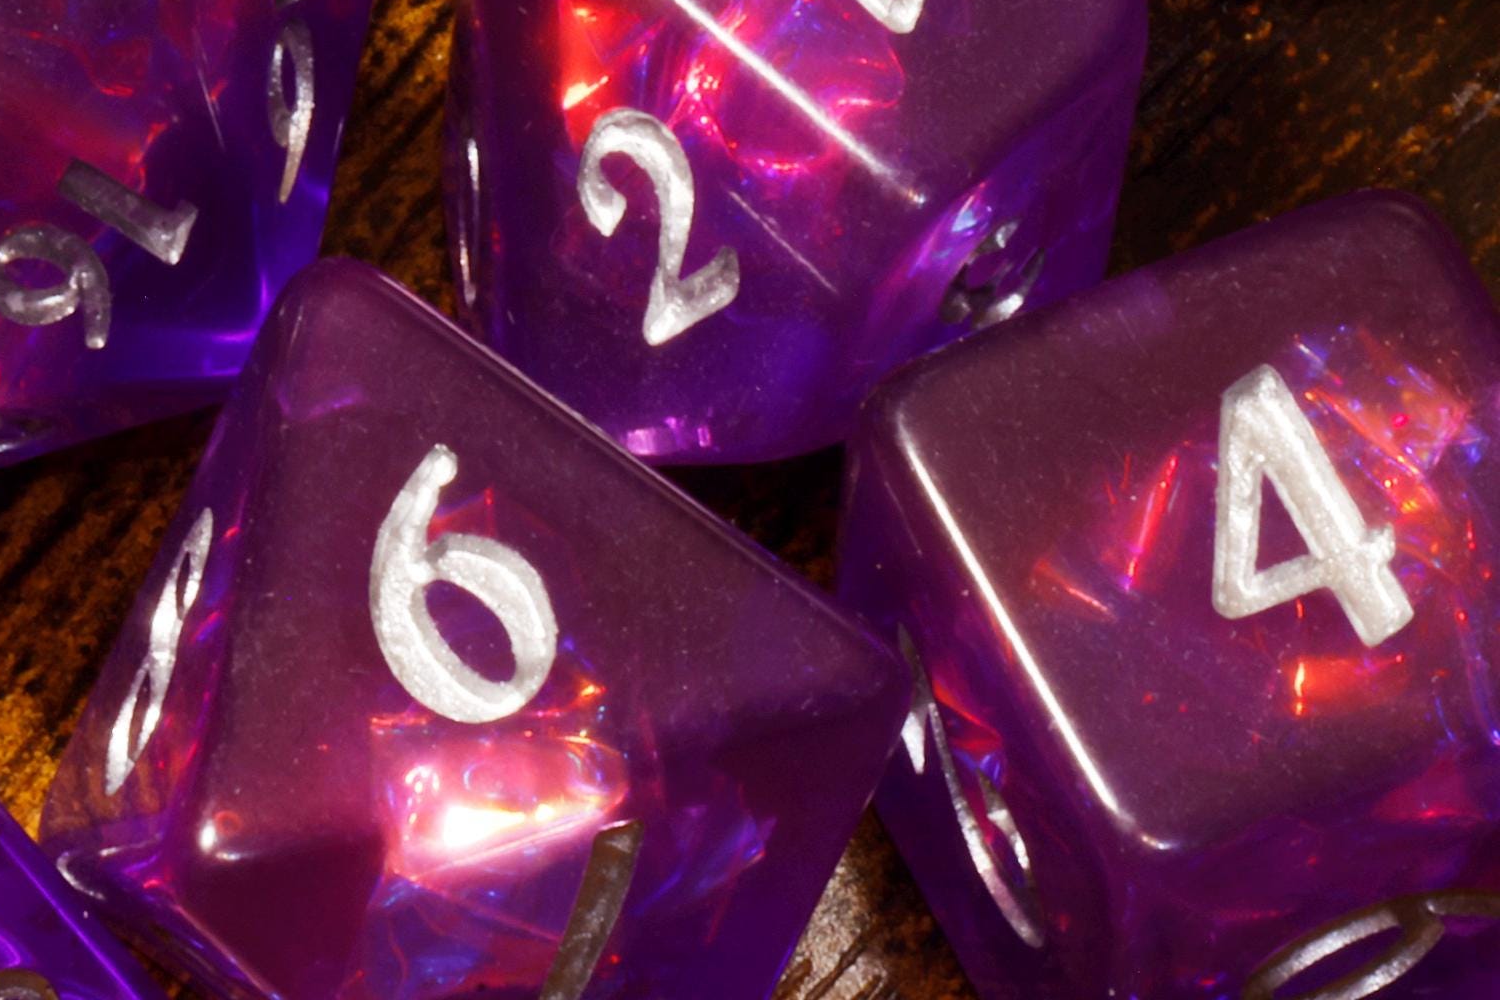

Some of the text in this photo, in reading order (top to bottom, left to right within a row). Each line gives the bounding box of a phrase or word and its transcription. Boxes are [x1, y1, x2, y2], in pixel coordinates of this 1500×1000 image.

[577, 106, 741, 346] 2
[369, 443, 559, 724] 6
[1212, 363, 1415, 648] 4
